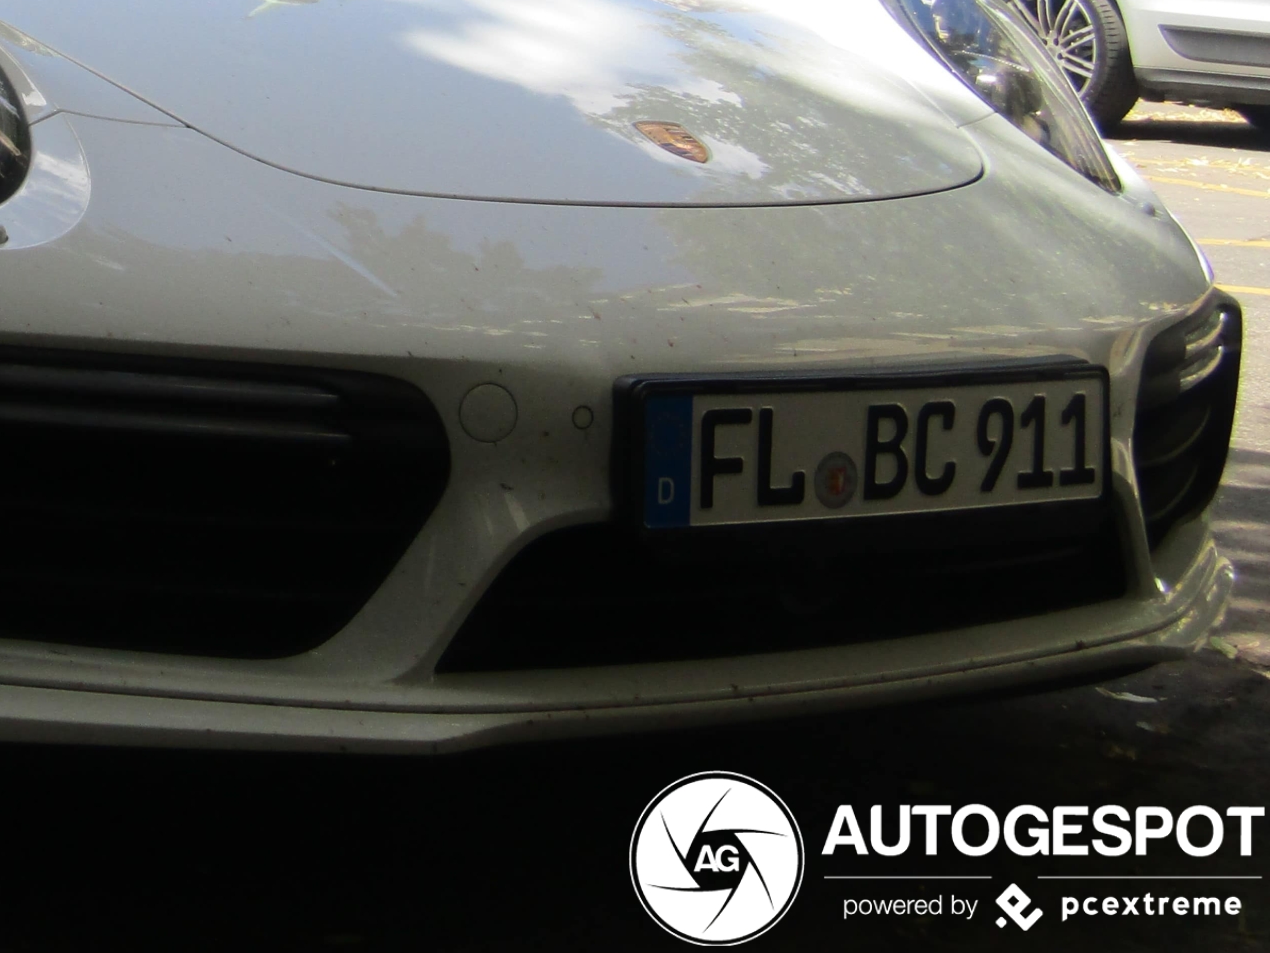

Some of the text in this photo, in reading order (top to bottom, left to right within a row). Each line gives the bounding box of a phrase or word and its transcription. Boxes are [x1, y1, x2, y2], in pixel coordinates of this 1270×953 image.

[699, 392, 1097, 510] FL BC 911
[657, 476, 675, 506] D
